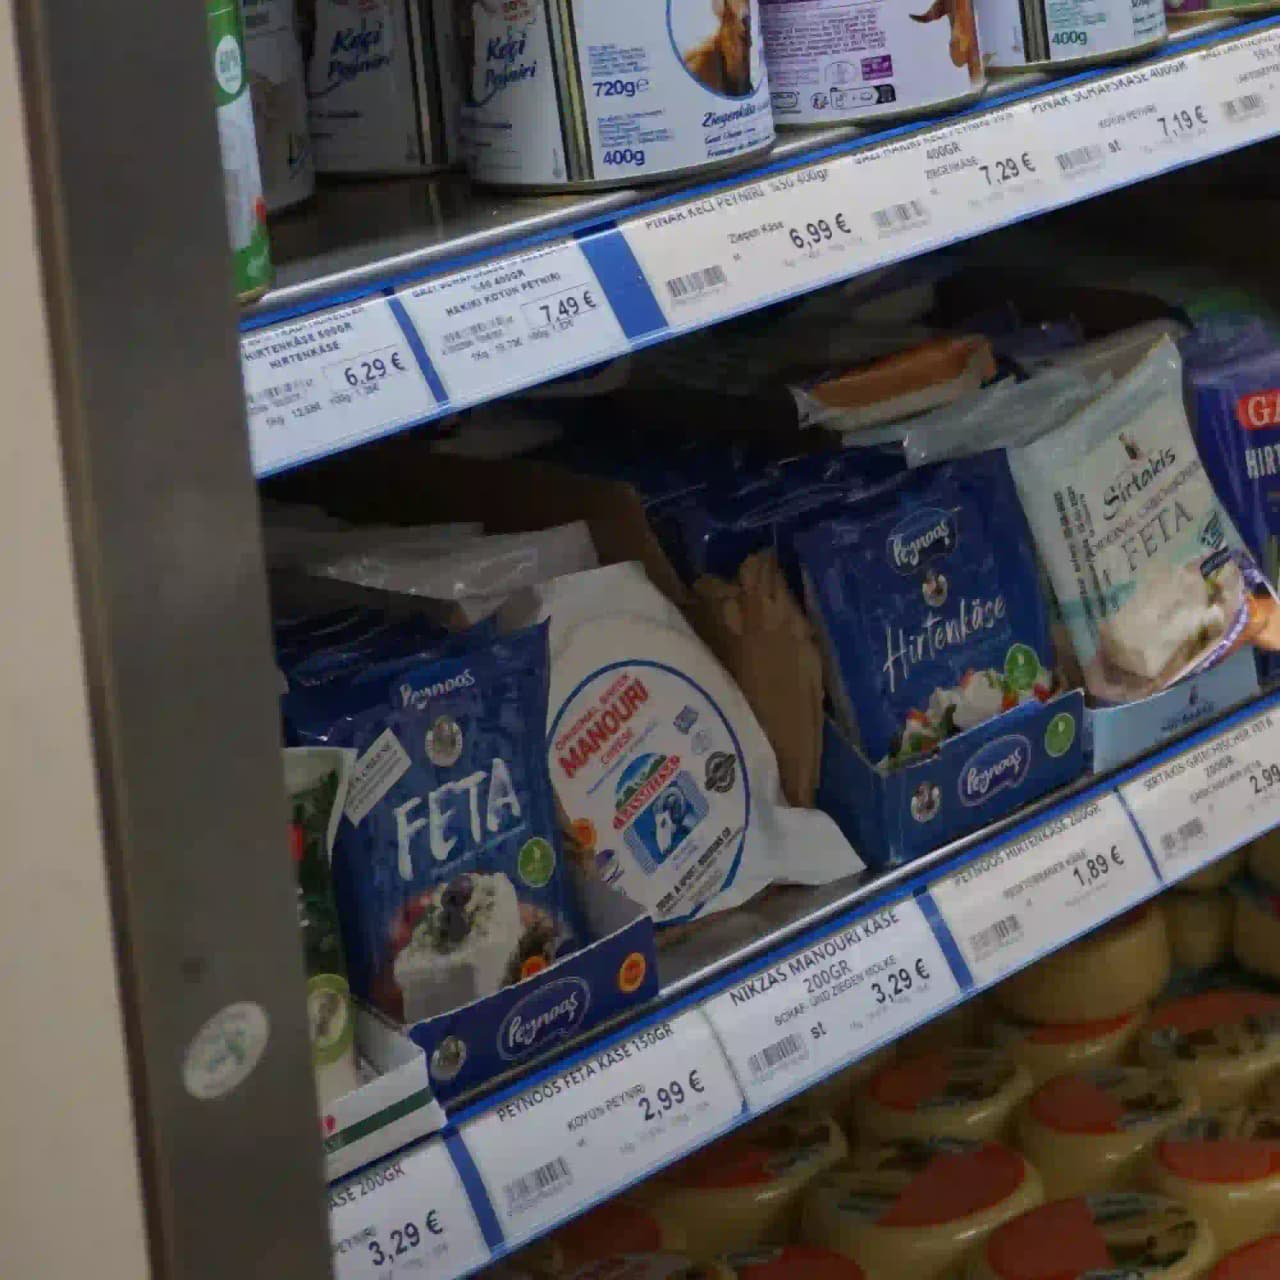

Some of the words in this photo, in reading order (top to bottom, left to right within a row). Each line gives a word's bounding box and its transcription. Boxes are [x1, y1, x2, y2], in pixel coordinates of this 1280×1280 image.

[1050, 30, 1088, 47] 400g
[592, 79, 637, 98] 720g
[1157, 109, 1194, 138] 7,19
[1195, 104, 1209, 125] €
[602, 148, 646, 166] 400g
[978, 157, 1020, 186] 7,29
[1021, 151, 1037, 173] €
[789, 218, 833, 252] 6,99
[835, 211, 852, 235] €
[583, 290, 597, 310] €
[390, 350, 408, 372] €
[1103, 446, 1177, 521] Sirtakis
[891, 518, 953, 569] Peynoos
[1121, 500, 1194, 572] FETA
[882, 593, 1008, 695] Hirtenkäse
[400, 667, 476, 711] Peynoos
[558, 676, 649, 780] MANOURI
[966, 745, 1025, 797] Peynoos
[393, 757, 523, 881] FETA
[1072, 853, 1111, 888] 1,89
[1110, 843, 1125, 867] €
[729, 969, 788, 1008] NIKZAS
[787, 931, 863, 977] MANOURI
[802, 959, 854, 994] 200GR
[830, 973, 864, 1005] ZIEGEN
[871, 965, 915, 1006] 3,29
[914, 956, 931, 981] €
[507, 990, 580, 1049] Peynoos
[496, 1082, 564, 1123] PEYNOOS
[563, 1063, 599, 1093] FETA
[632, 1022, 676, 1056] 150GR
[637, 1078, 685, 1122] 2,99
[687, 1068, 707, 1094] €
[358, 1164, 406, 1197] 200GR
[367, 1220, 424, 1268] 3,29
[423, 1208, 445, 1236] €
